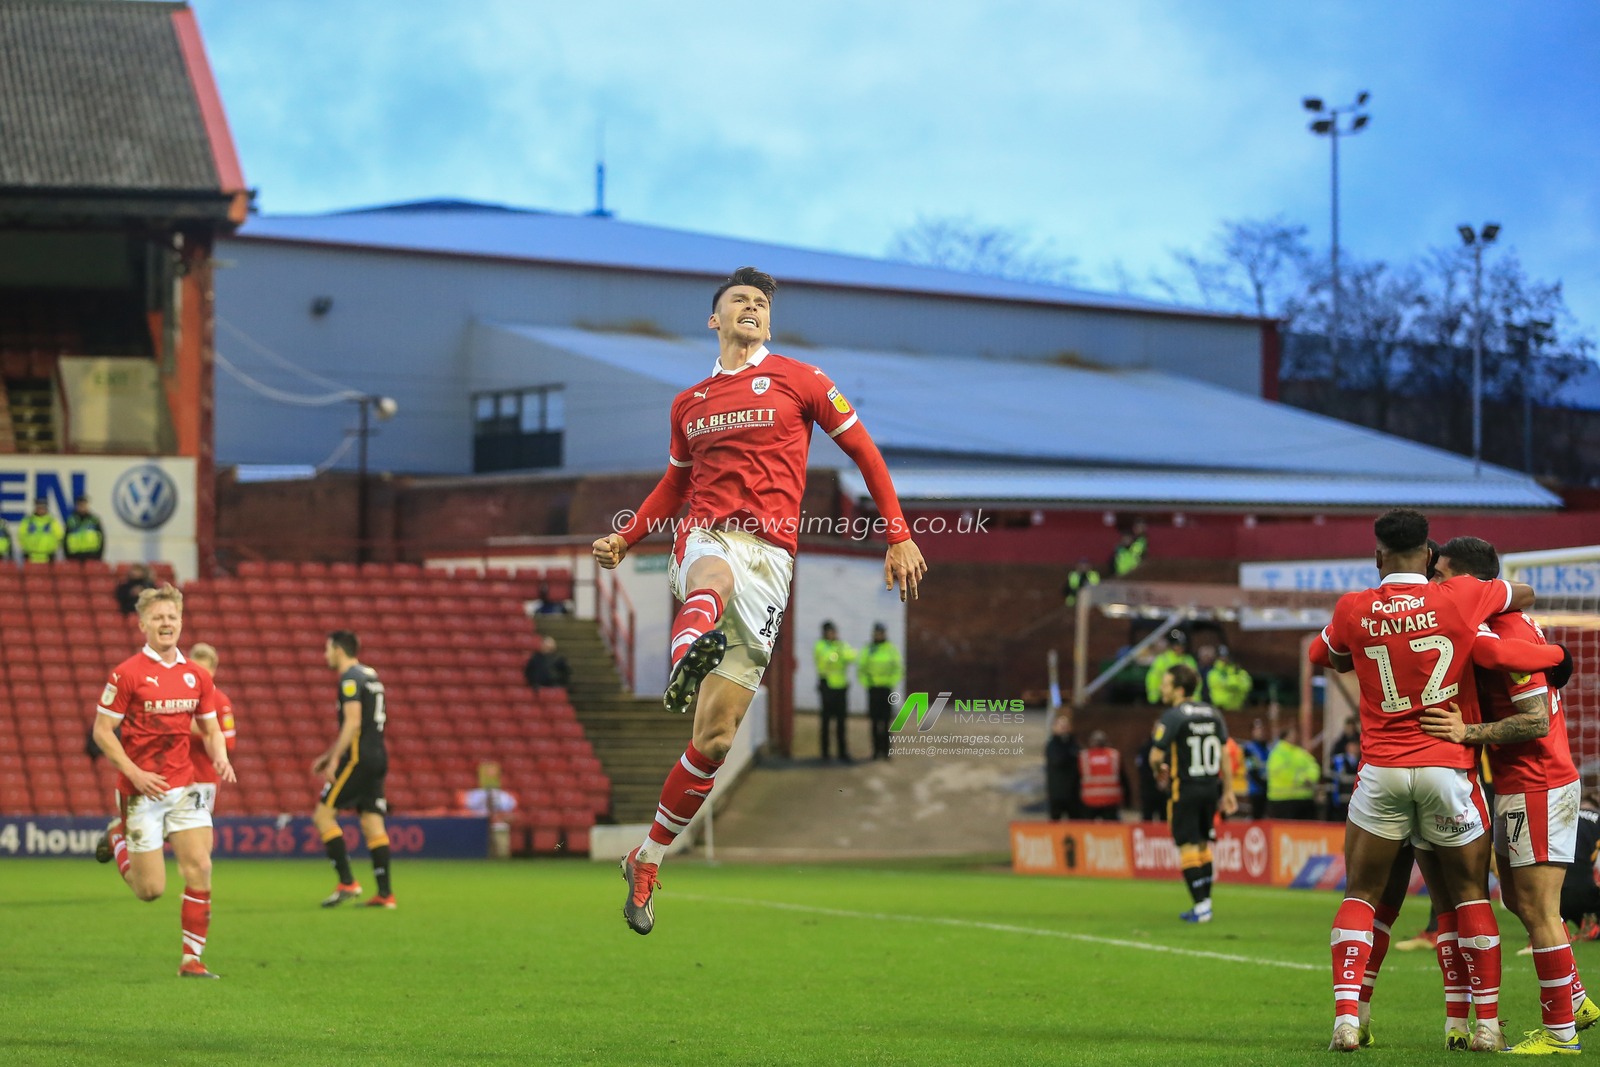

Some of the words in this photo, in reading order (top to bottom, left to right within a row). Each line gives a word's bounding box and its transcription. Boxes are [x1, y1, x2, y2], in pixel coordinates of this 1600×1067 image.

[686, 408, 776, 435] C.K.BECKETT
[1371, 595, 1425, 614] Palmer
[1368, 611, 1439, 637] CAVARE
[1363, 635, 1459, 713] 12
[144, 699, 199, 710] C.K.BECKET
[1186, 735, 1221, 777] 10
[213, 825, 296, 854] 1226
